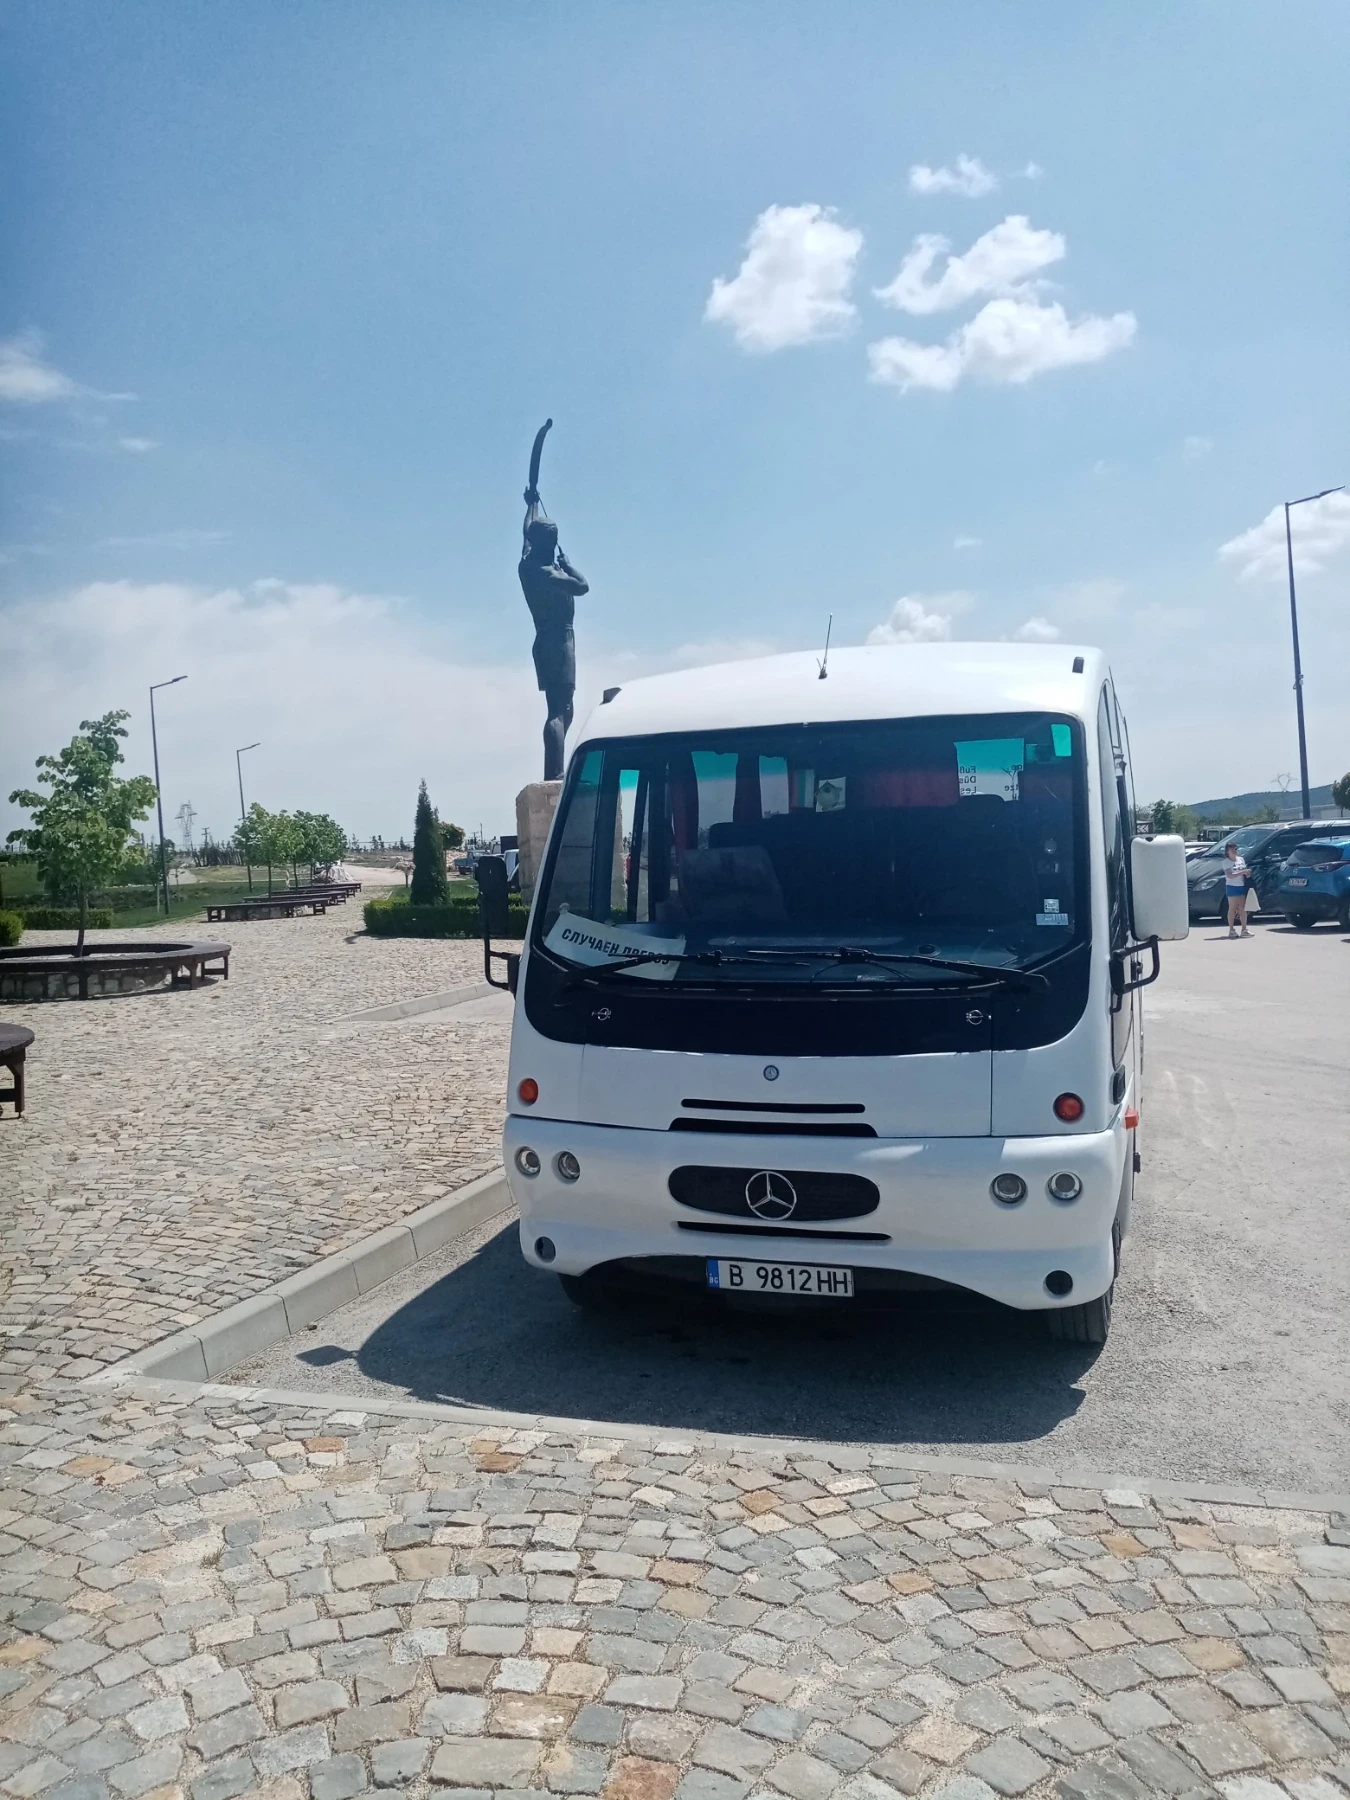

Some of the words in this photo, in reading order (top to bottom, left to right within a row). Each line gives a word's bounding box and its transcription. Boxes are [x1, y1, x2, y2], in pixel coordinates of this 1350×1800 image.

[561, 928, 620, 954] СЛУЧАЕН
[709, 1276, 719, 1284] BG
[729, 1264, 744, 1287] B
